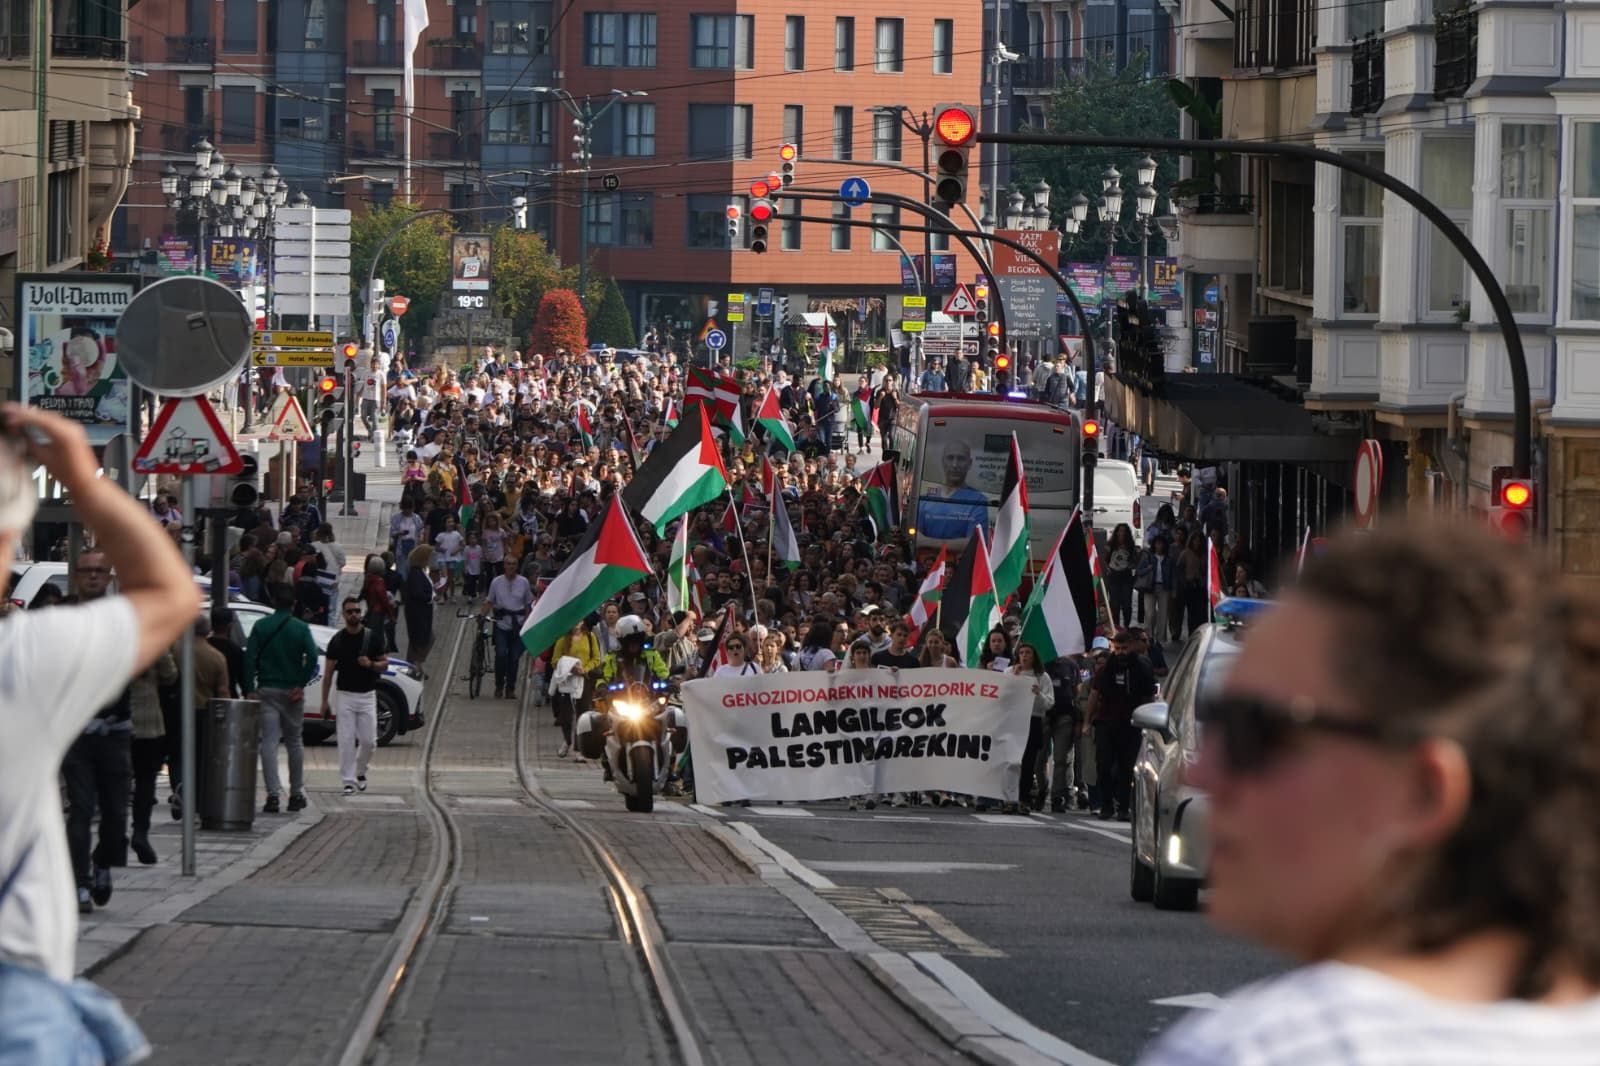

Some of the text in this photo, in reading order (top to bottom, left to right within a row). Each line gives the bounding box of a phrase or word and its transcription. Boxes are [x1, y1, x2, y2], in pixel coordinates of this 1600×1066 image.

[29, 286, 128, 306] Voll-Damm
[722, 682, 999, 708] GENOZIDIOAREKIN NEGOZIORIK EZ
[771, 703, 947, 738] LANGILEOK
[726, 731, 992, 769] PALESTINAREKIN!
